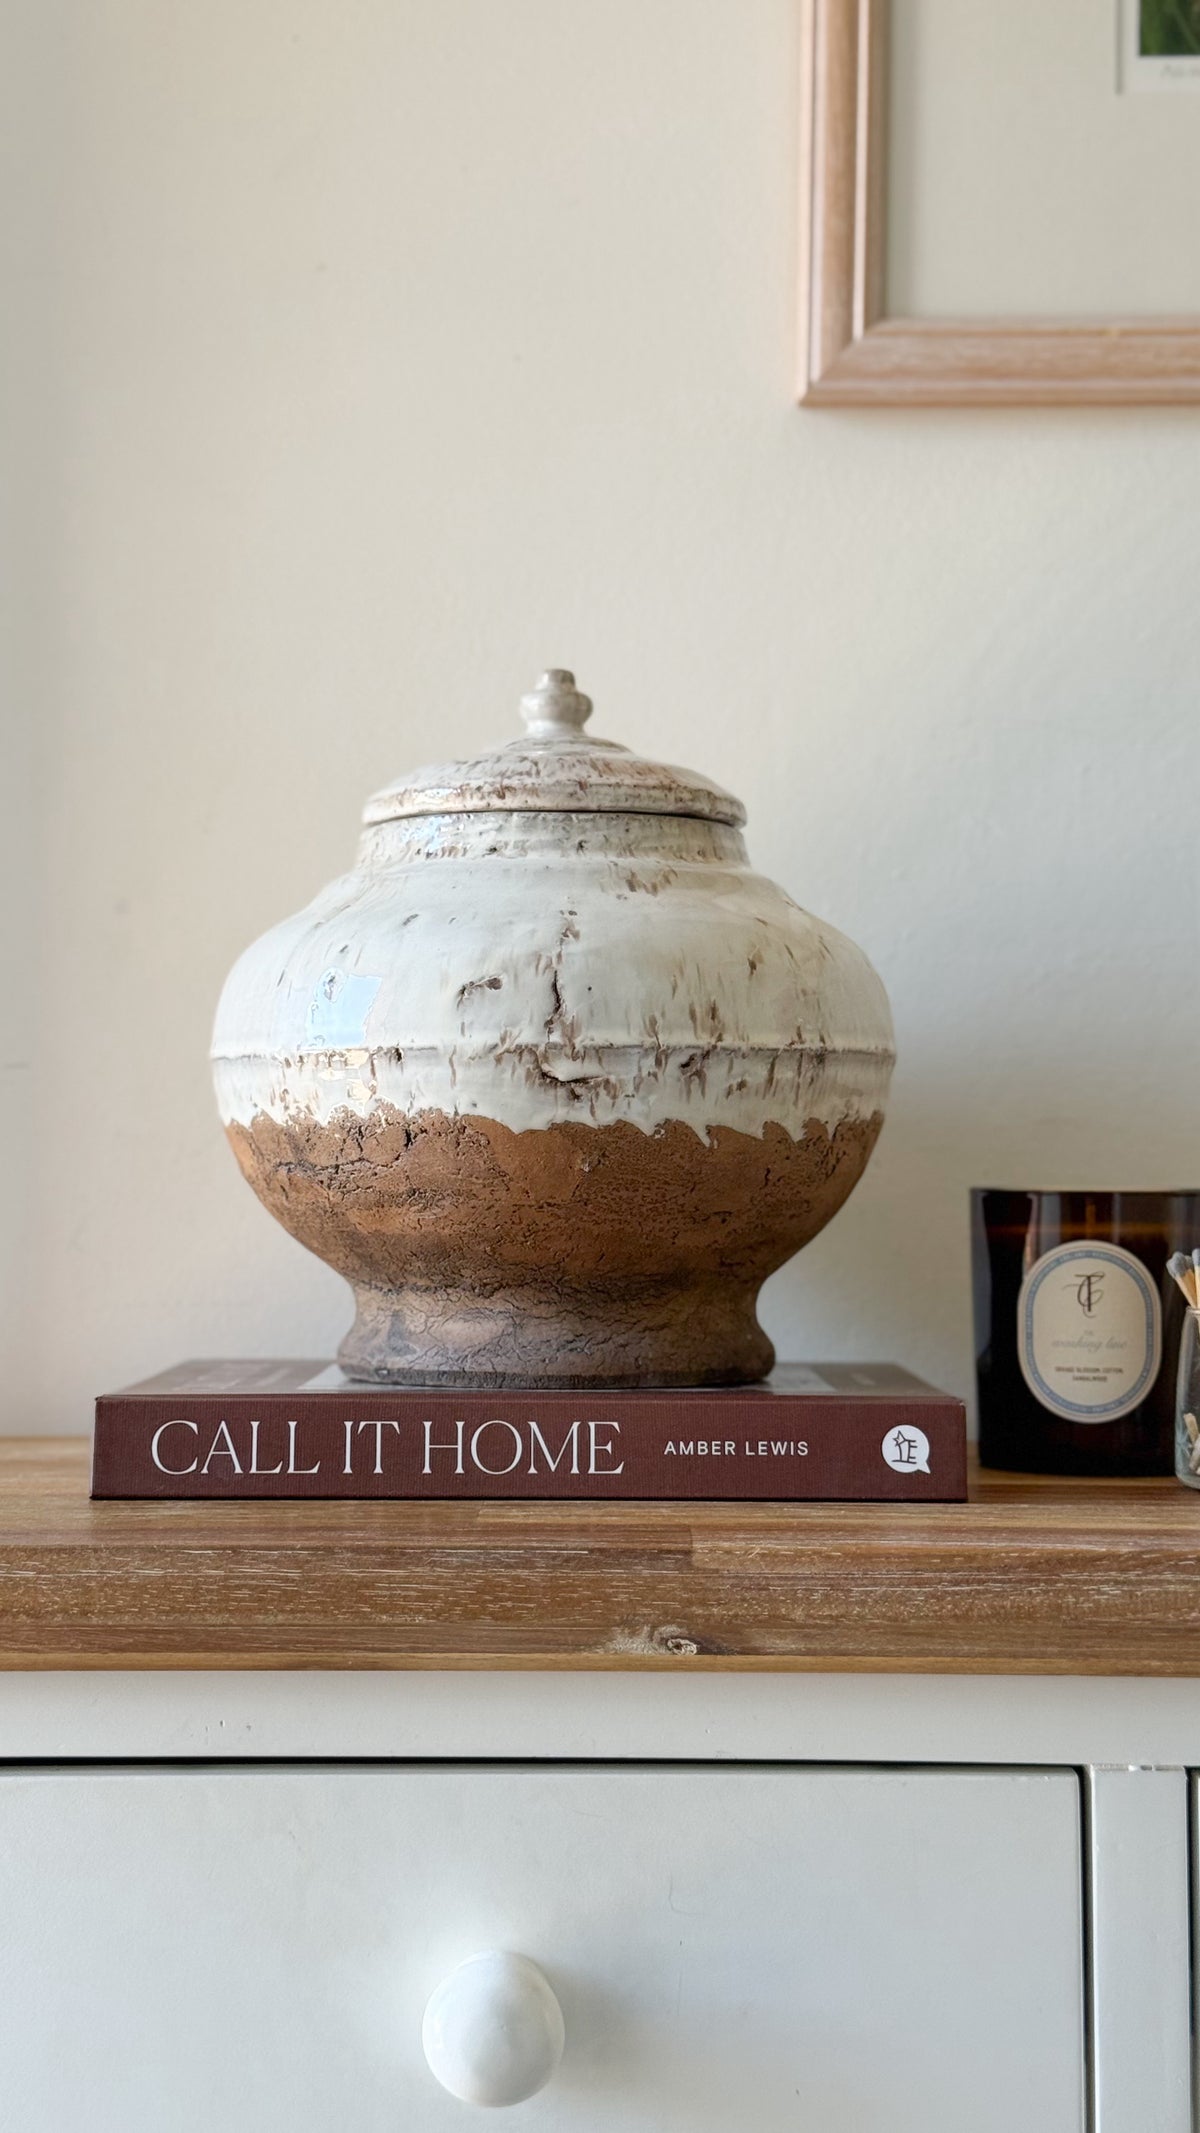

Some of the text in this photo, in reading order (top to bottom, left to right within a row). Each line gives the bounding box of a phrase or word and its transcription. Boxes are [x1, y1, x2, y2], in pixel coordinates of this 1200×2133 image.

[152, 1421, 809, 1474] CALL IT HOME AMBER LEWIS
